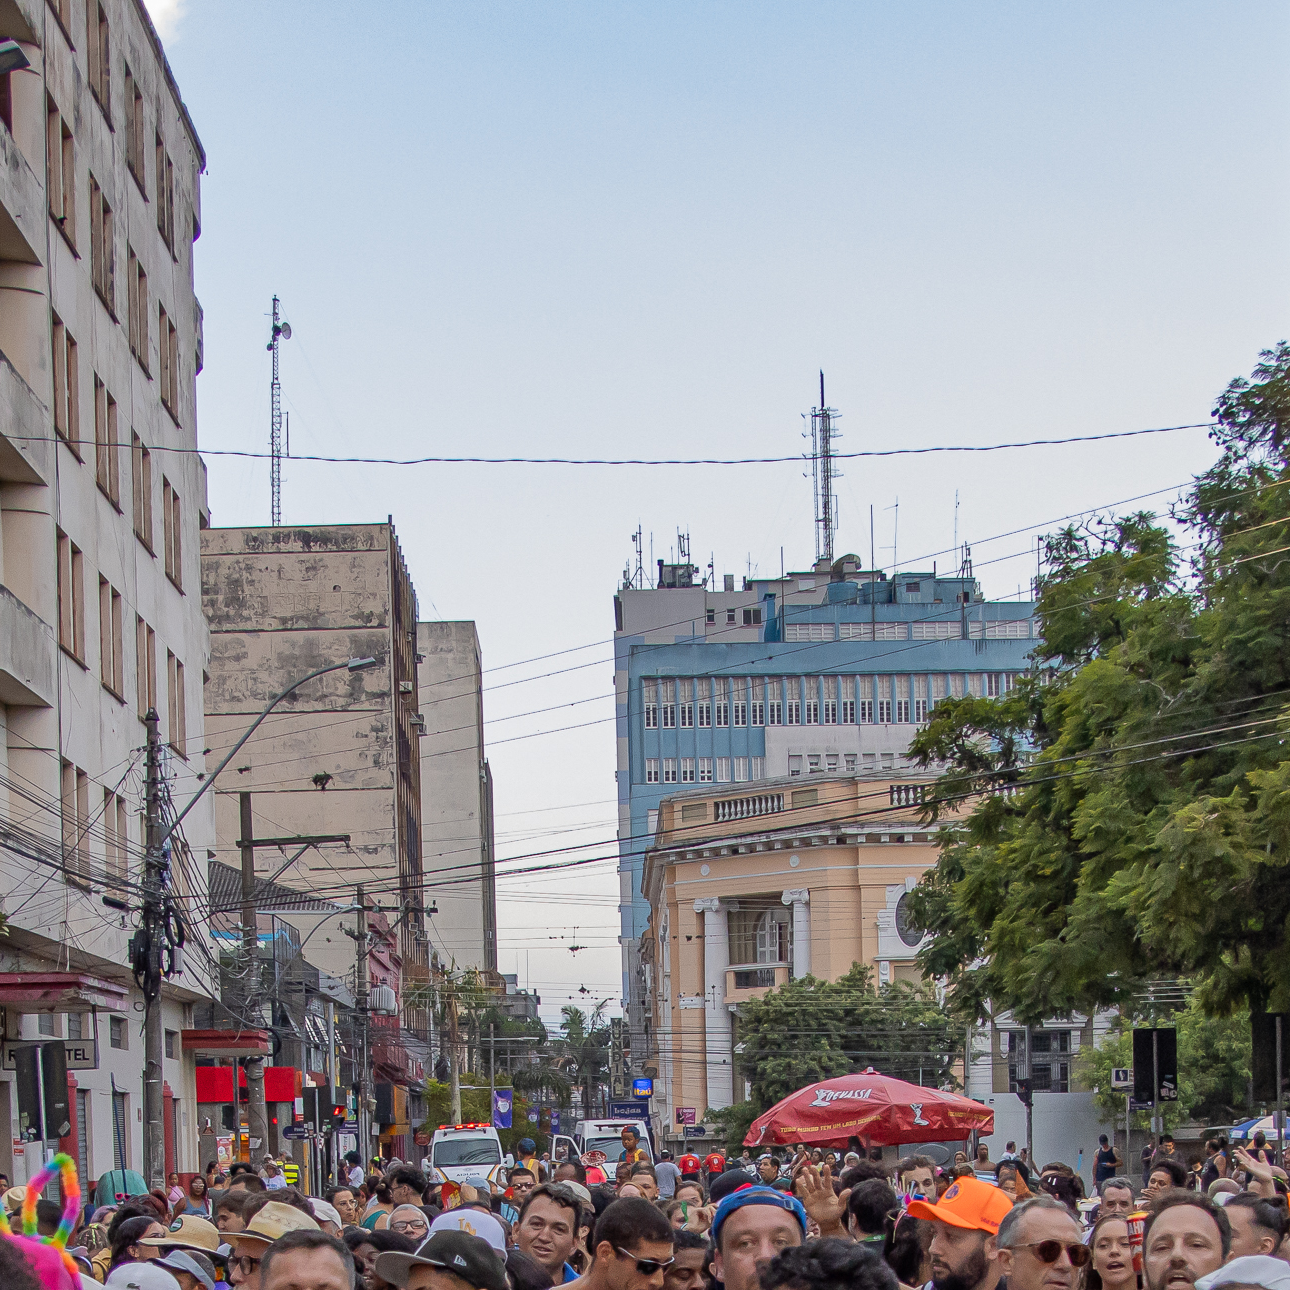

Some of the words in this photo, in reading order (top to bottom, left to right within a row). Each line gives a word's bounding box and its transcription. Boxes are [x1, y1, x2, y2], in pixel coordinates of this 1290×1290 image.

[65, 1049, 90, 1061] TEL
[611, 1018, 623, 1097] MUNDIAL
[825, 1088, 873, 1101] DEVASSA
